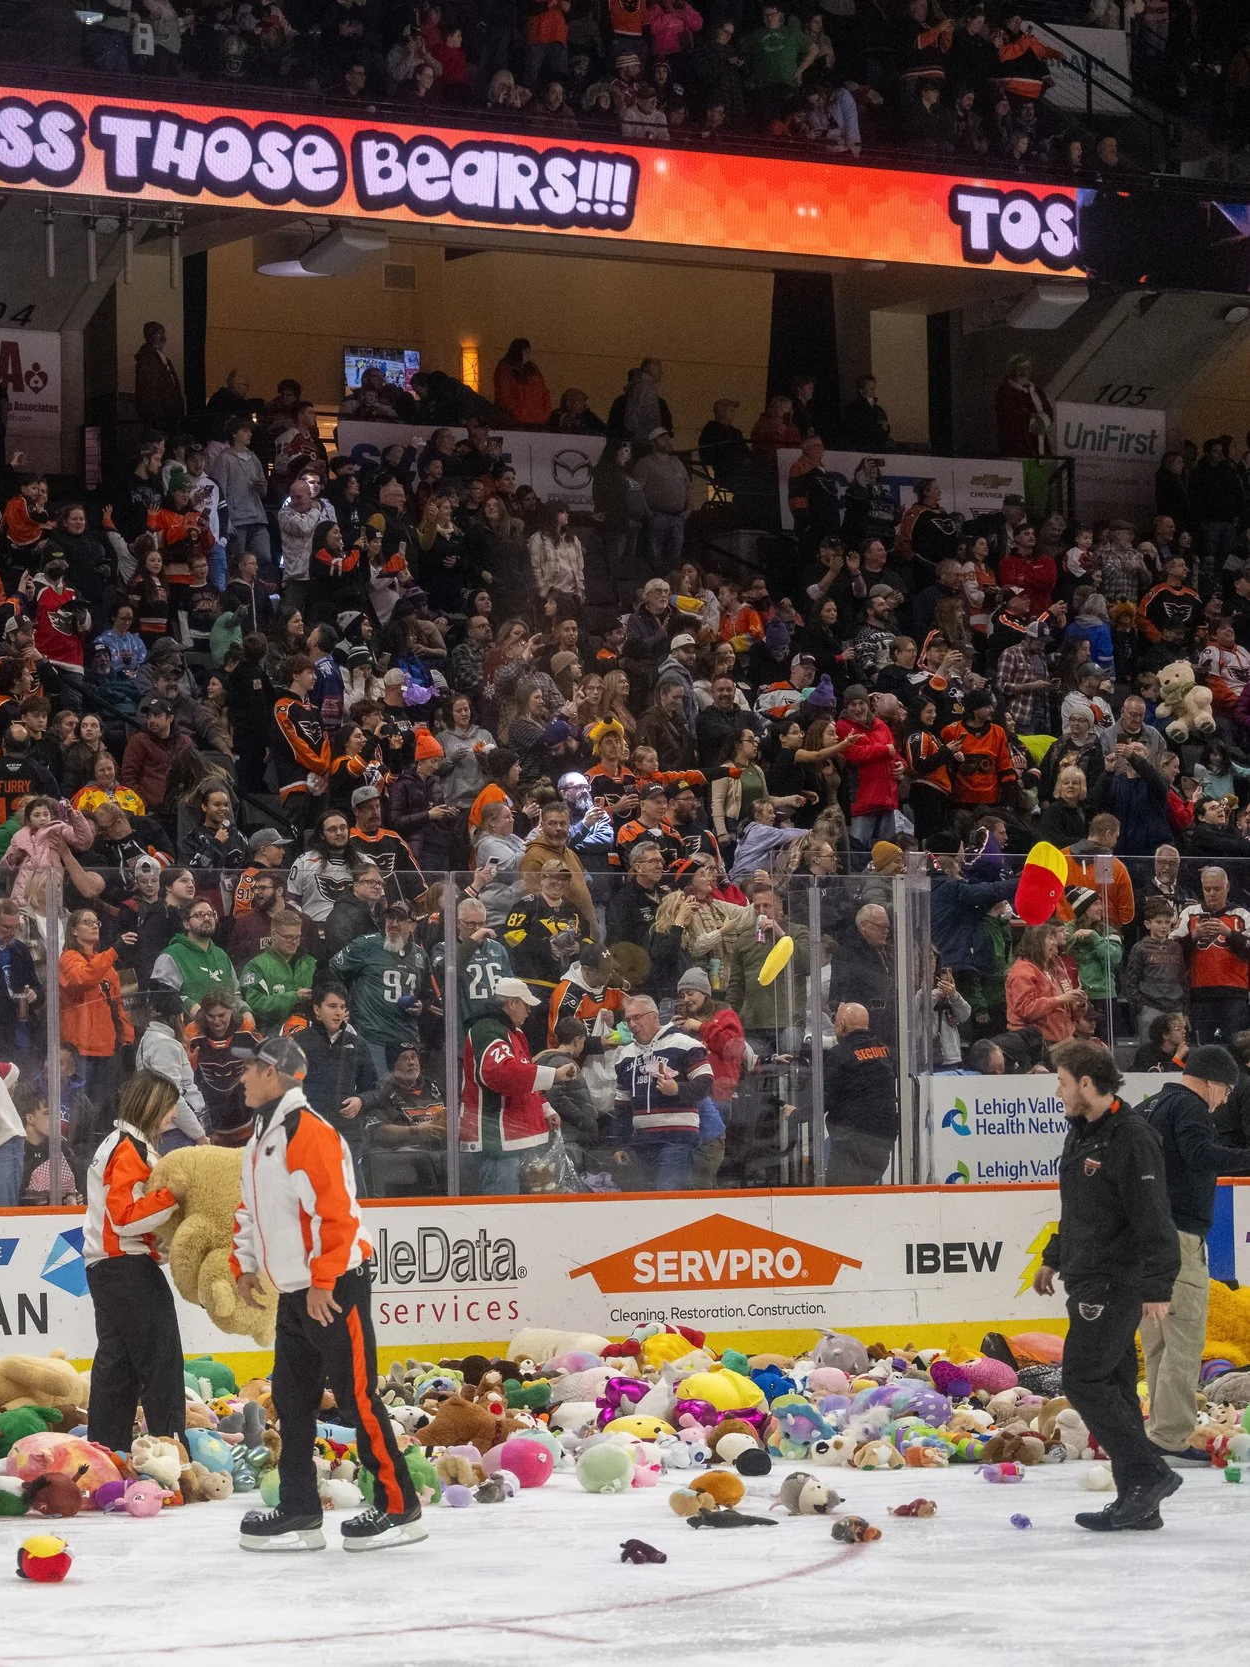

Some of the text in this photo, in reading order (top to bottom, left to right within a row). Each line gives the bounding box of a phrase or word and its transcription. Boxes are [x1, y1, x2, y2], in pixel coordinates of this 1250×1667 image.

[957, 194, 1080, 257] TOS
[1094, 384, 1155, 405] 105
[14, 401, 59, 414] Associates
[1064, 422, 1159, 455] UniFirst
[970, 491, 1005, 499] CHEVROL
[236, 889, 250, 900] 91
[507, 912, 527, 927] 87
[466, 963, 503, 999] 26
[975, 1097, 1064, 1118] Lehigh Valle
[976, 1116, 1073, 1135] Health Netwo
[978, 1159, 1060, 1180] Lehigh Vall
[905, 1241, 1003, 1274] IBEW
[379, 1295, 519, 1325] services
[610, 1302, 826, 1323] Cleaning. Restoration. Construction.
